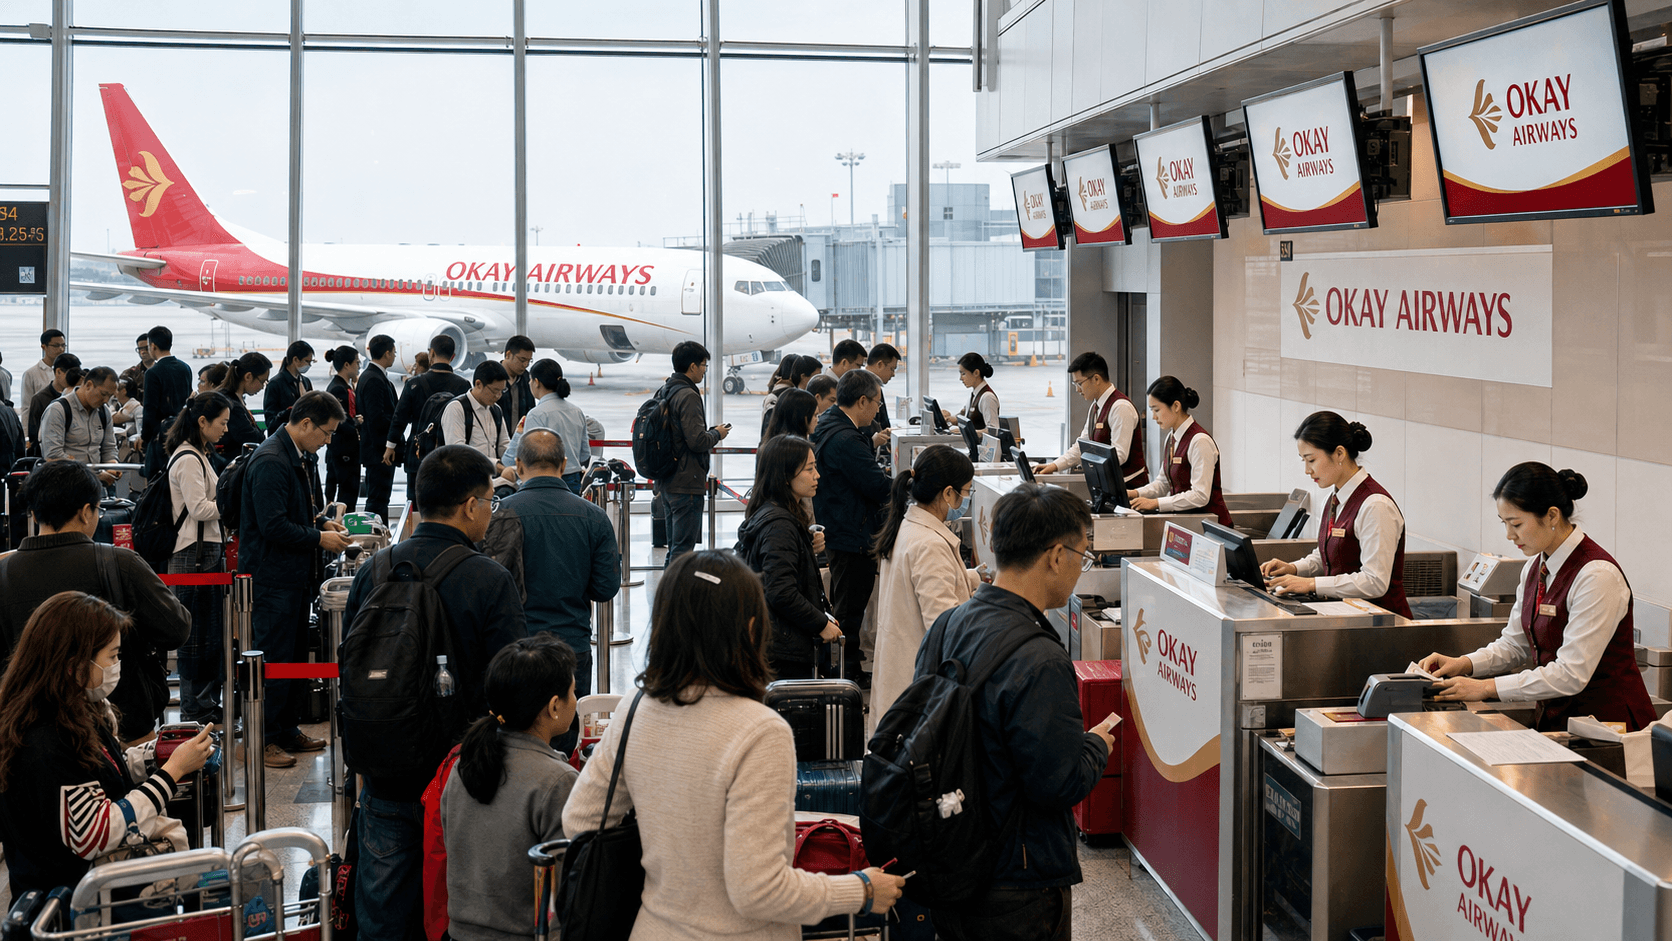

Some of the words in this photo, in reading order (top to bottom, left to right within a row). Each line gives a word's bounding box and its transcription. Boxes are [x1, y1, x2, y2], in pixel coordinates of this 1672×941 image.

[1507, 73, 1571, 119] OKAY
[1292, 126, 1329, 157] OKAY
[1512, 117, 1578, 147] AIRWAYS
[1169, 157, 1194, 182] OKAY
[1297, 158, 1335, 178] AIRWAYS
[1173, 183, 1198, 198] AIRWAYS
[446, 261, 516, 282] OKAY
[527, 263, 655, 285] AIRWAYS
[1326, 286, 1389, 329] OKAY
[1396, 289, 1513, 338] AIRWAYS
[1157, 629, 1197, 676] OKAY
[1157, 661, 1197, 701] AIRWAYS
[1457, 844, 1532, 934] OKAY
